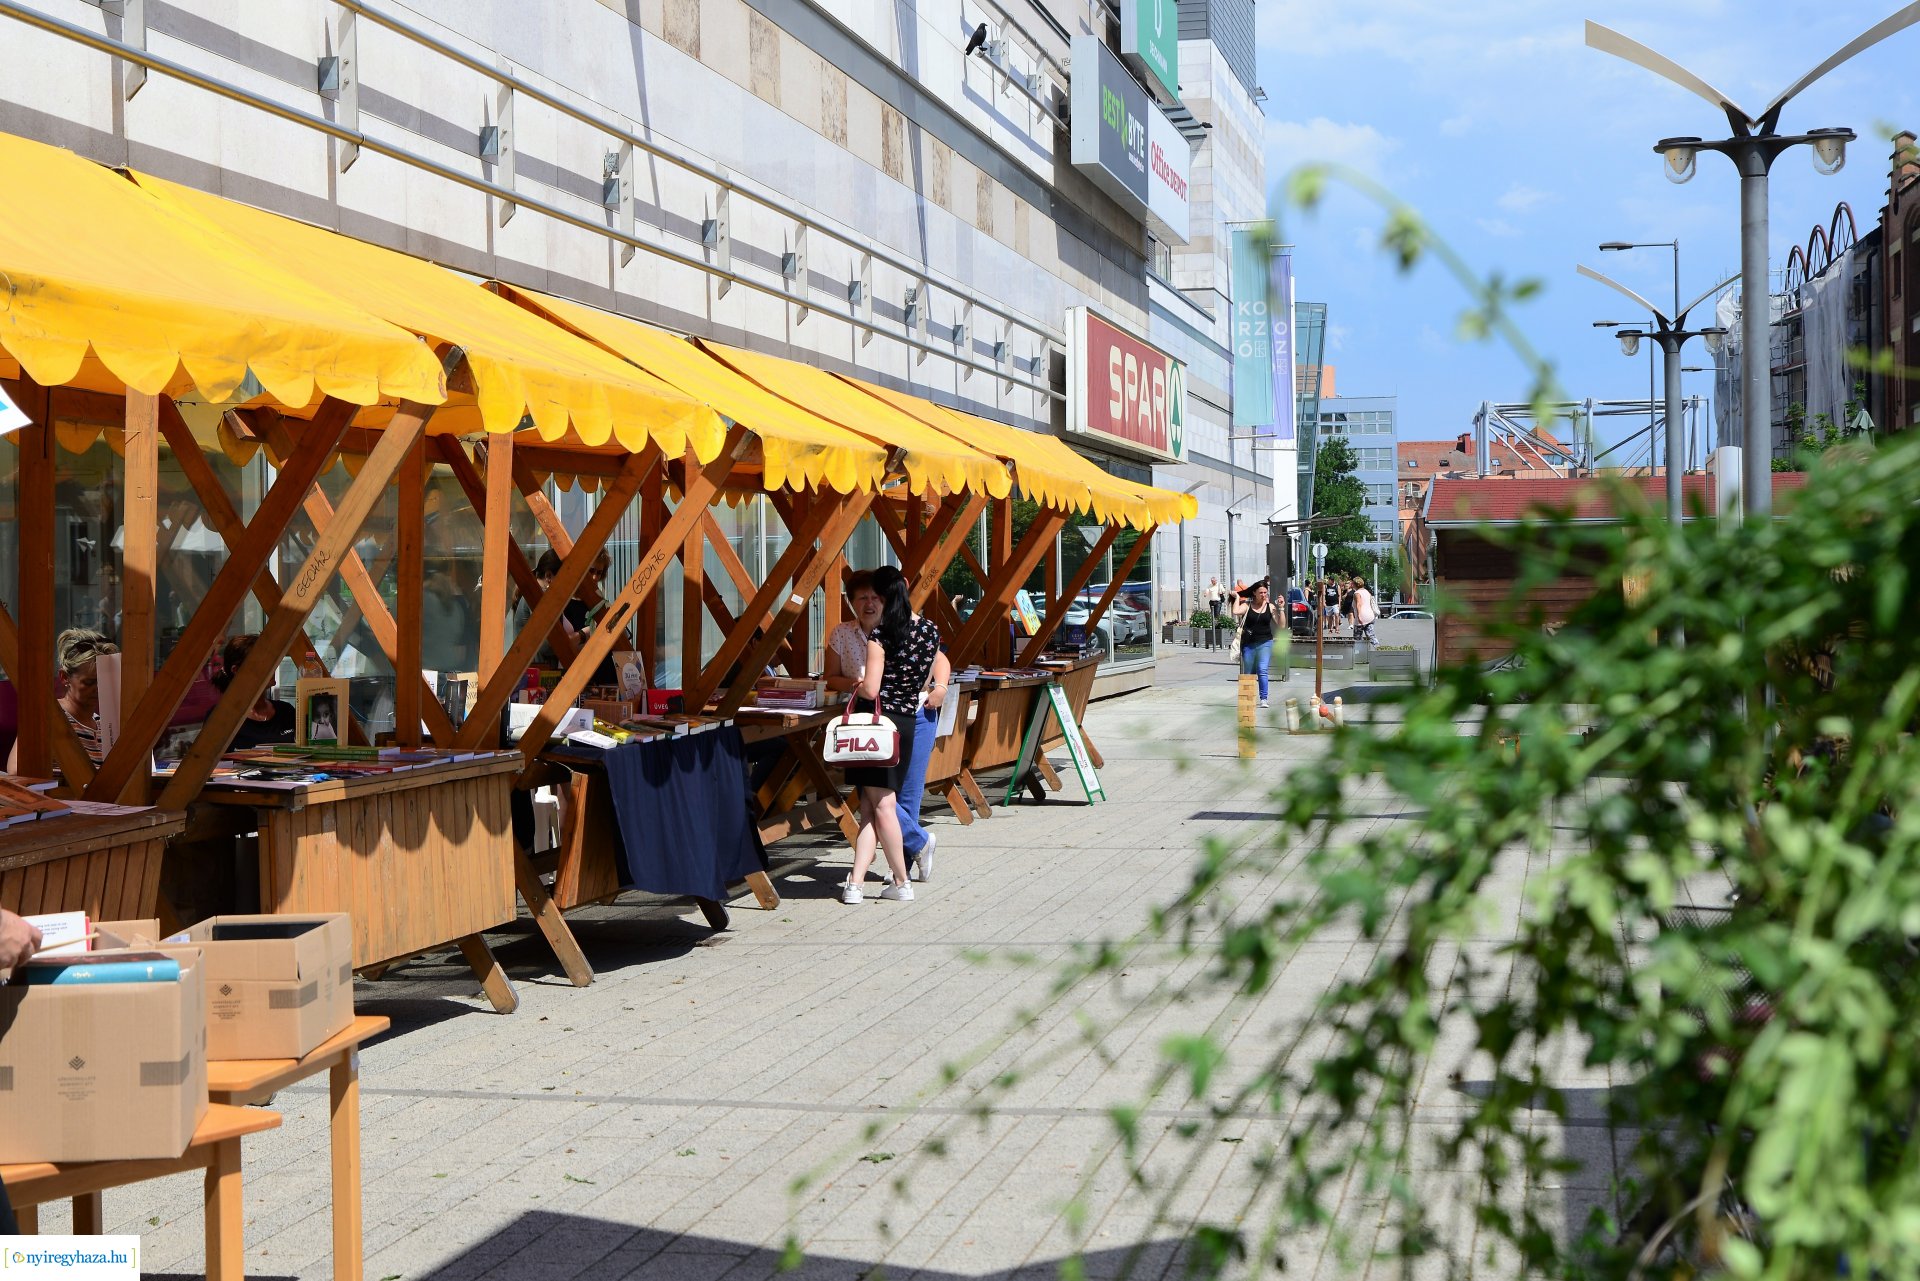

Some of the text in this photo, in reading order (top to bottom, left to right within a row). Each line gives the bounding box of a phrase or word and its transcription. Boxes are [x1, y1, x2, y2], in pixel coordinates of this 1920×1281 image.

[1102, 83, 1121, 133] BEST
[1128, 112, 1145, 159] BYTE
[1150, 141, 1188, 202] Office DEPOT
[1109, 345, 1166, 436] SPAR
[632, 548, 666, 595] GEO476
[835, 736, 880, 754] FILA
